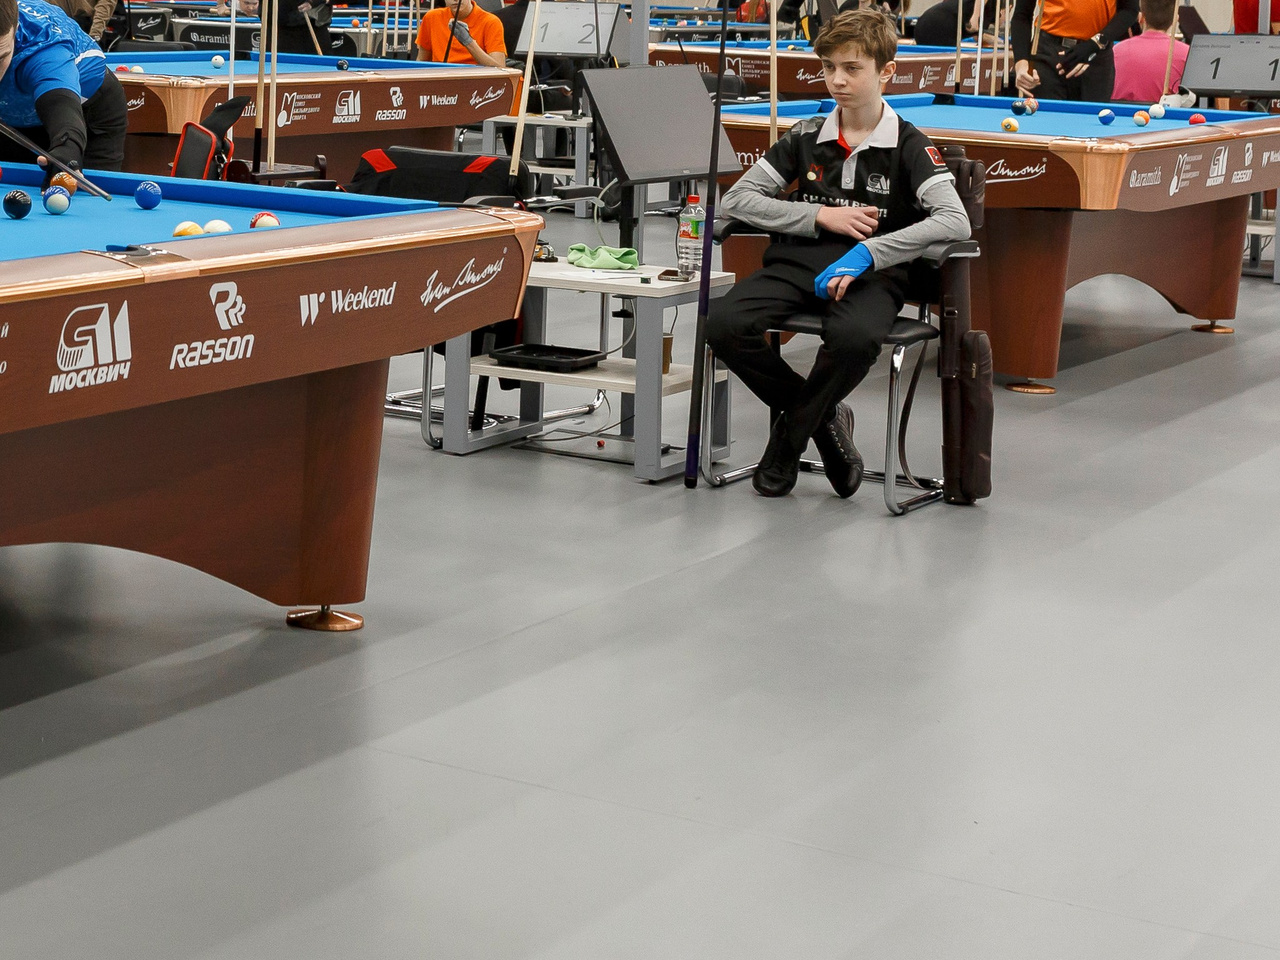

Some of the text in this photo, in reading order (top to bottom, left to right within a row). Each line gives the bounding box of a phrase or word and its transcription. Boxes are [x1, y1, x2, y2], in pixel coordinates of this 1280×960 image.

[540, 22, 596, 44] 1 2
[1209, 57, 1280, 81] 1 1
[431, 94, 458, 106] Weekend
[332, 114, 362, 124] МОСКВИЧ
[331, 281, 398, 315] Weekend
[49, 361, 132, 394] МОСКВИЧ
